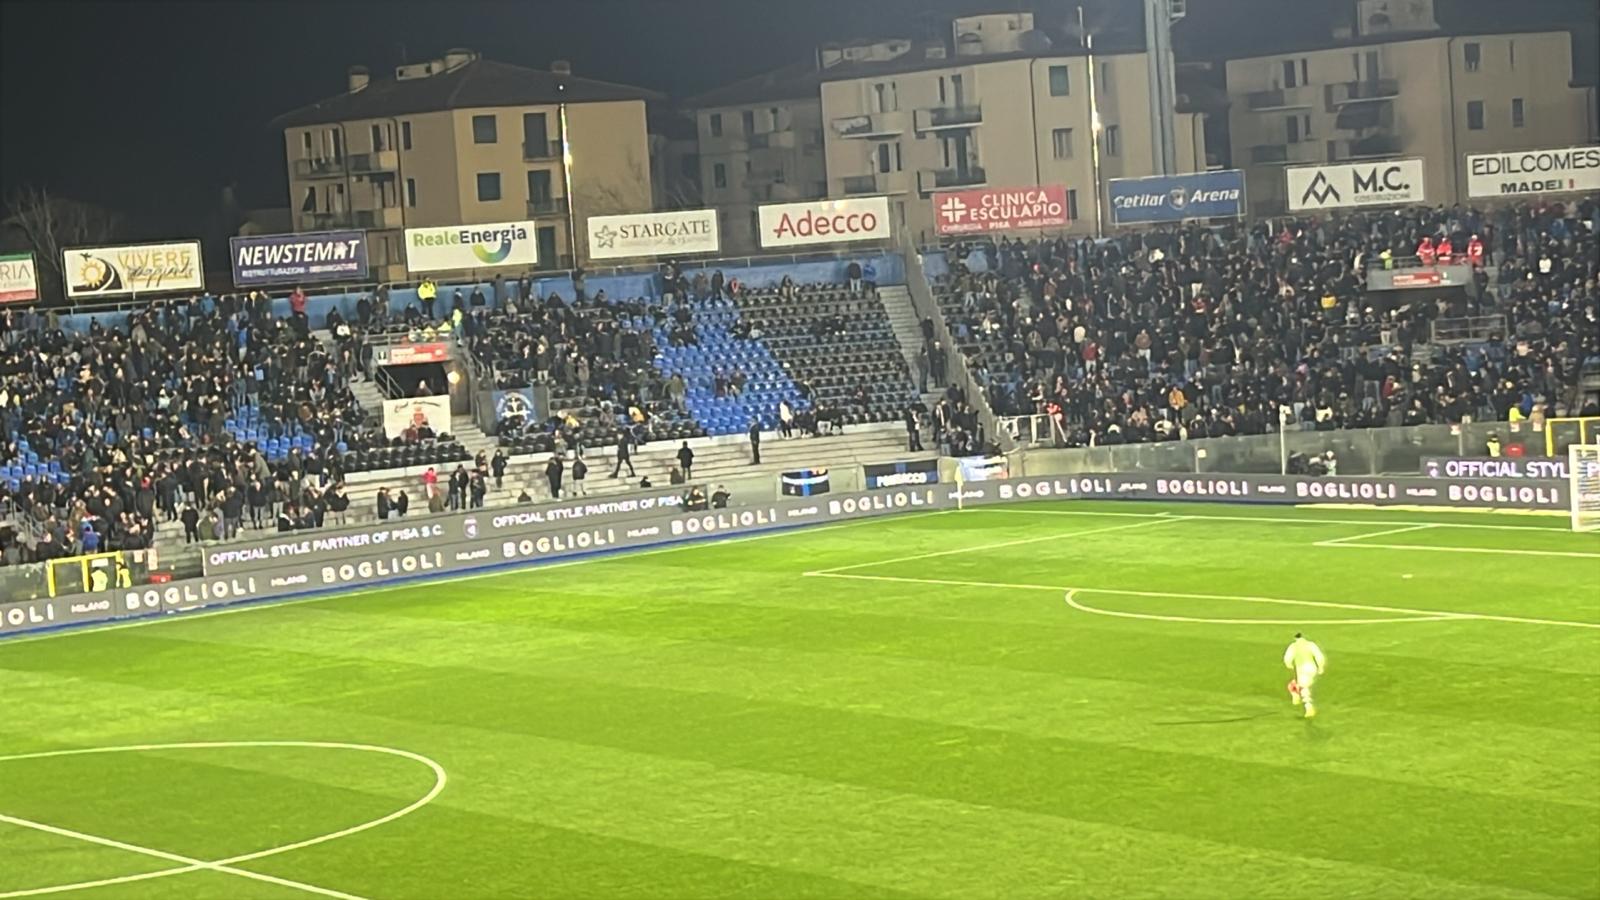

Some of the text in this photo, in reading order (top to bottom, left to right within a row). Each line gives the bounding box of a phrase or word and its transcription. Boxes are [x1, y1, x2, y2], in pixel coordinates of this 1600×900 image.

[1472, 150, 1600, 176] EDILCOMES
[1353, 166, 1410, 193] M.C.
[981, 191, 1048, 207] CLINICA
[1113, 188, 1240, 208] Cetilar Arena
[773, 210, 877, 239] Adecco
[970, 202, 1061, 221] ESCULAPIO
[620, 219, 711, 239] STARGATE
[1445, 461, 1523, 477] OFFICIAL
[1526, 461, 1570, 478] STYL
[492, 495, 683, 528] OFFICIAL STYLE PARTNER OF PISA
[126, 577, 256, 610] BOGLIOLI
[322, 552, 442, 583] BOGLIOLI
[503, 529, 615, 558] BOGLIOLI
[671, 508, 777, 536] BOGLIOLI
[829, 490, 933, 515] BOGLIOLI
[999, 478, 1111, 499] BOGLIOLI
[1157, 479, 1249, 496] BOGLIOLI
[1296, 481, 1396, 499] BOGLIOLI
[1448, 485, 1558, 504] BOGLIOLI
[210, 547, 269, 566] OFFICIAL
[271, 541, 310, 558] STYLE
[313, 534, 370, 553] PARTNER
[372, 530, 389, 544] OF
[392, 527, 419, 541] PISA
